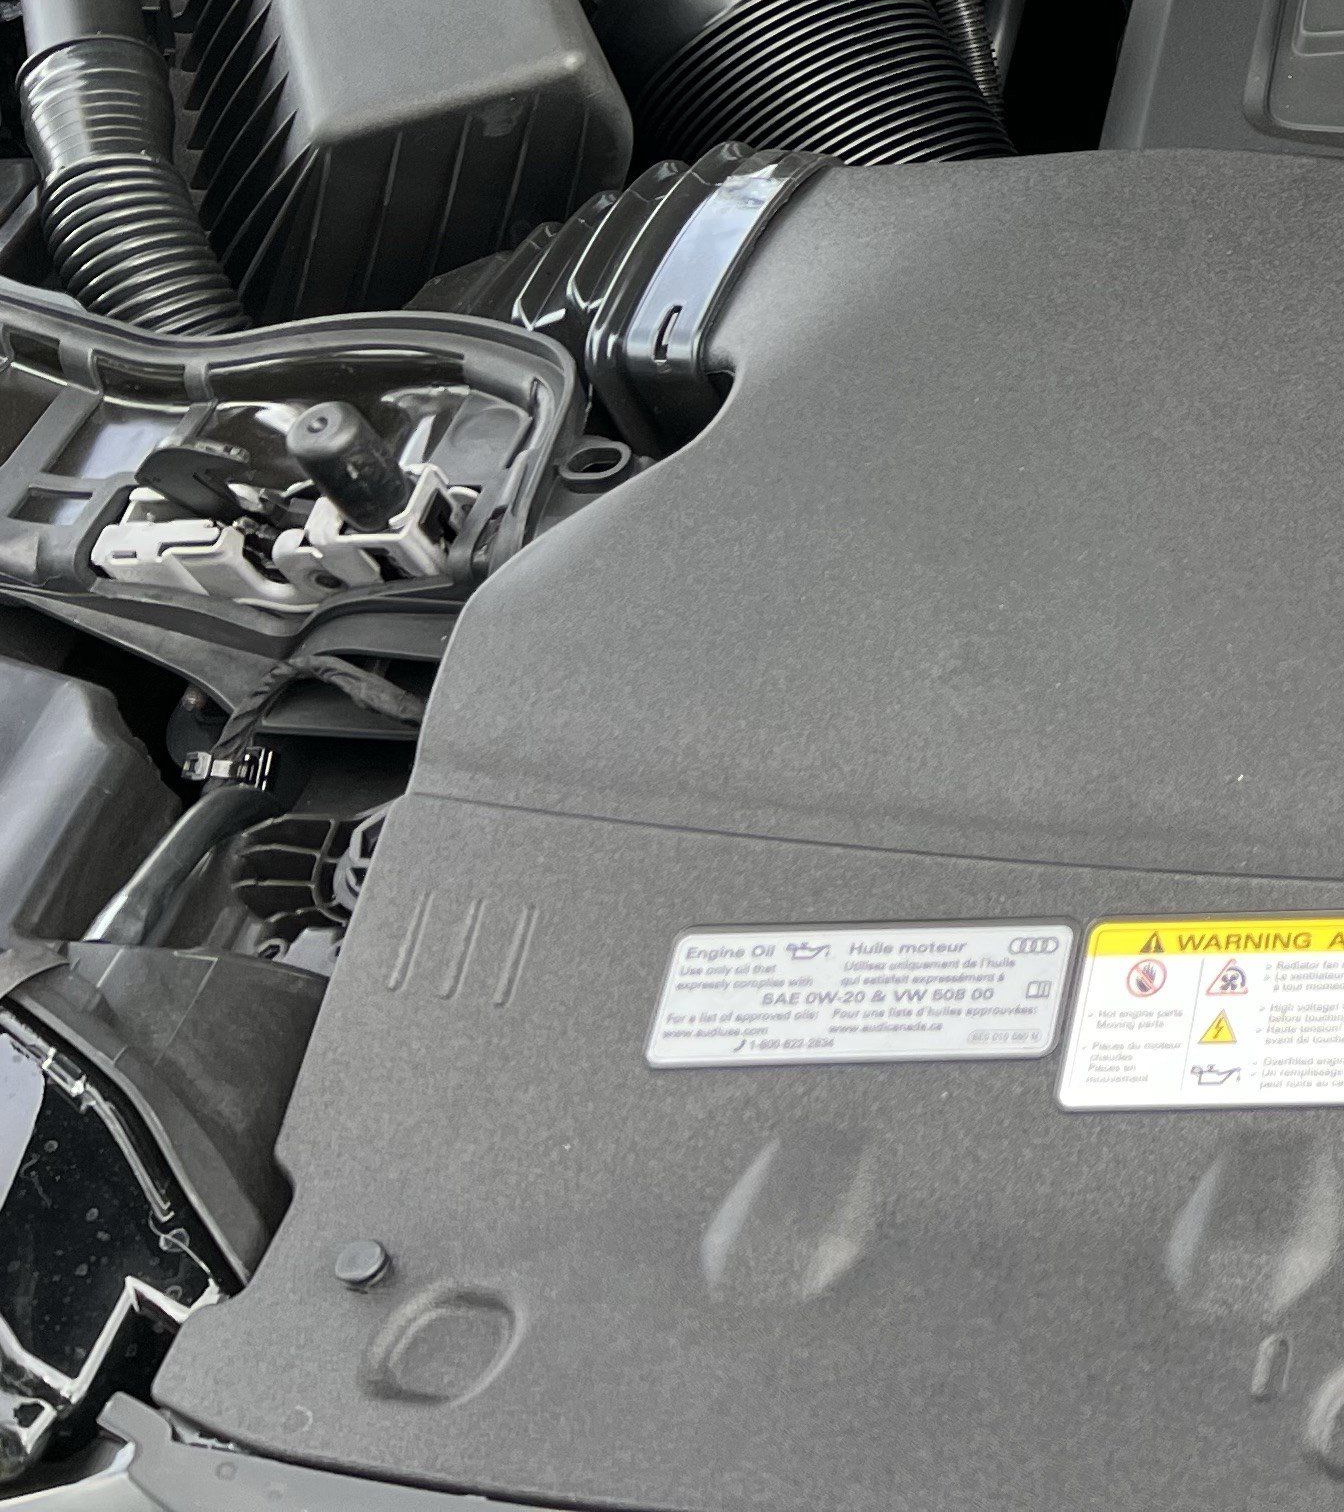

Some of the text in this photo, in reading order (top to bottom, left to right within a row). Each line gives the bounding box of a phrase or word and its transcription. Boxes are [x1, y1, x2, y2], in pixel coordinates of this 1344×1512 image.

[849, 941, 968, 956] Huile moteur
[1177, 931, 1312, 952] WARNING
[686, 943, 777, 961] Engine Oil
[680, 963, 777, 978] Use only oil that
[888, 958, 961, 972] uniquement
[962, 957, 978, 969] de
[1276, 960, 1319, 970] Radiator
[1322, 960, 1340, 970] fan
[676, 976, 814, 992] expressly complies with
[840, 975, 861, 988] qui
[1274, 972, 1288, 982] Le
[761, 992, 802, 1006] SAE
[804, 990, 867, 1005] 0W-20
[870, 989, 887, 1003] &
[893, 988, 929, 1002] VW
[970, 987, 996, 1001] 00
[831, 1007, 861, 1020] Pour
[862, 1008, 885, 1019] une
[1156, 1008, 1184, 1020] parts
[1269, 1002, 1294, 1014] High
[667, 1014, 686, 1025] For
[699, 1012, 718, 1023] list
[719, 1010, 734, 1023] of
[735, 1010, 792, 1024] approved
